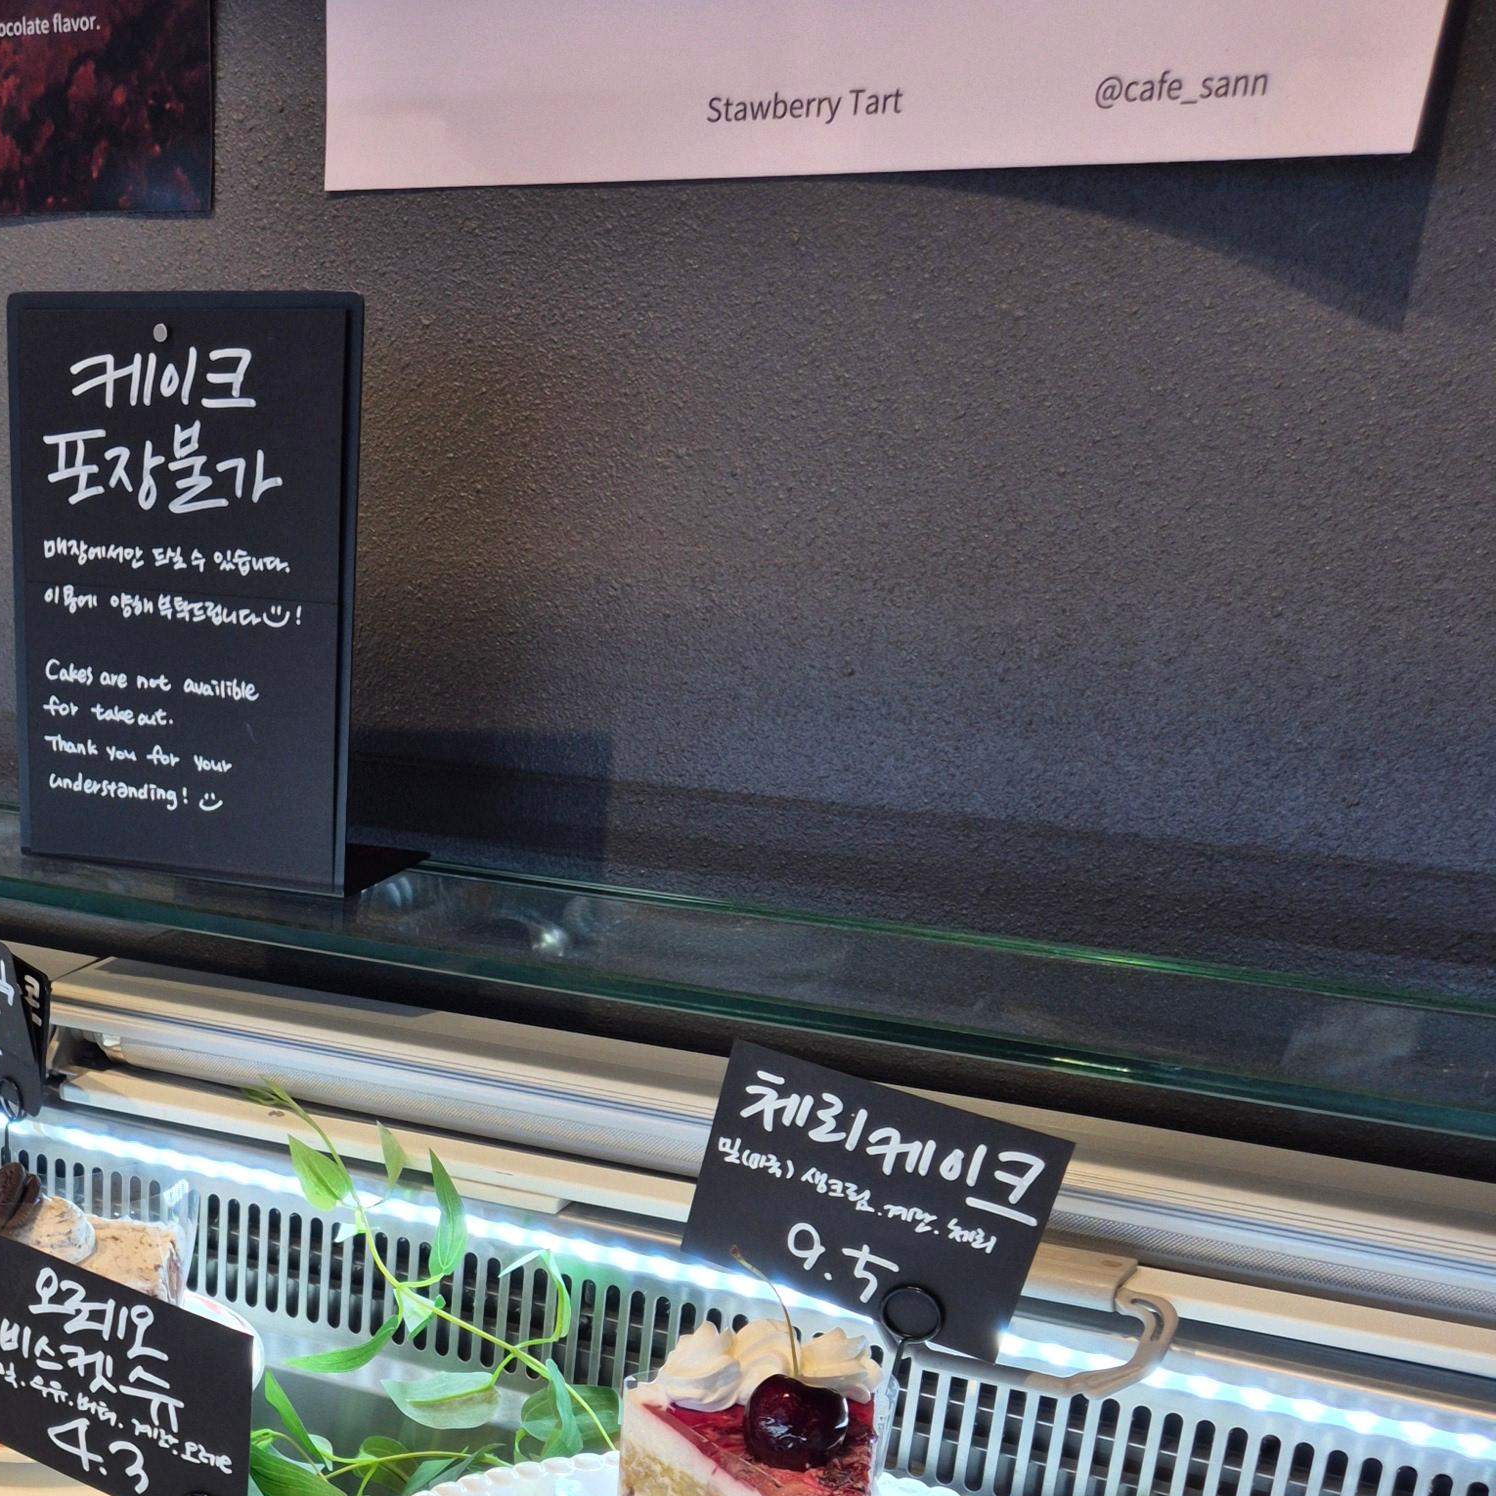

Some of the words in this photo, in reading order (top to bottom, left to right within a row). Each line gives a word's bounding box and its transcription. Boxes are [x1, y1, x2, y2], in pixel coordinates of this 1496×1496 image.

[52, 12, 101, 33] flavor.
[706, 92, 842, 125] Stawberry
[848, 88, 903, 116] Tart
[1095, 69, 1269, 110] @cafe_sann
[69, 345, 256, 409] 케이크
[42, 420, 283, 514] 포장불가
[43, 537, 145, 569] 매장에서만
[152, 547, 188, 571] 드실
[191, 549, 205, 573] 수
[44, 584, 98, 614] 이용에
[110, 593, 154, 618] 양해
[45, 658, 94, 686] Cakes
[100, 670, 128, 689] are
[136, 674, 172, 692] not
[43, 695, 79, 716] for
[44, 734, 99, 756] Thank
[146, 744, 181, 766] for
[787, 1222, 900, 1304] 9.5
[28, 1267, 169, 1362] 오레오
[47, 1418, 150, 1494] 4.3
